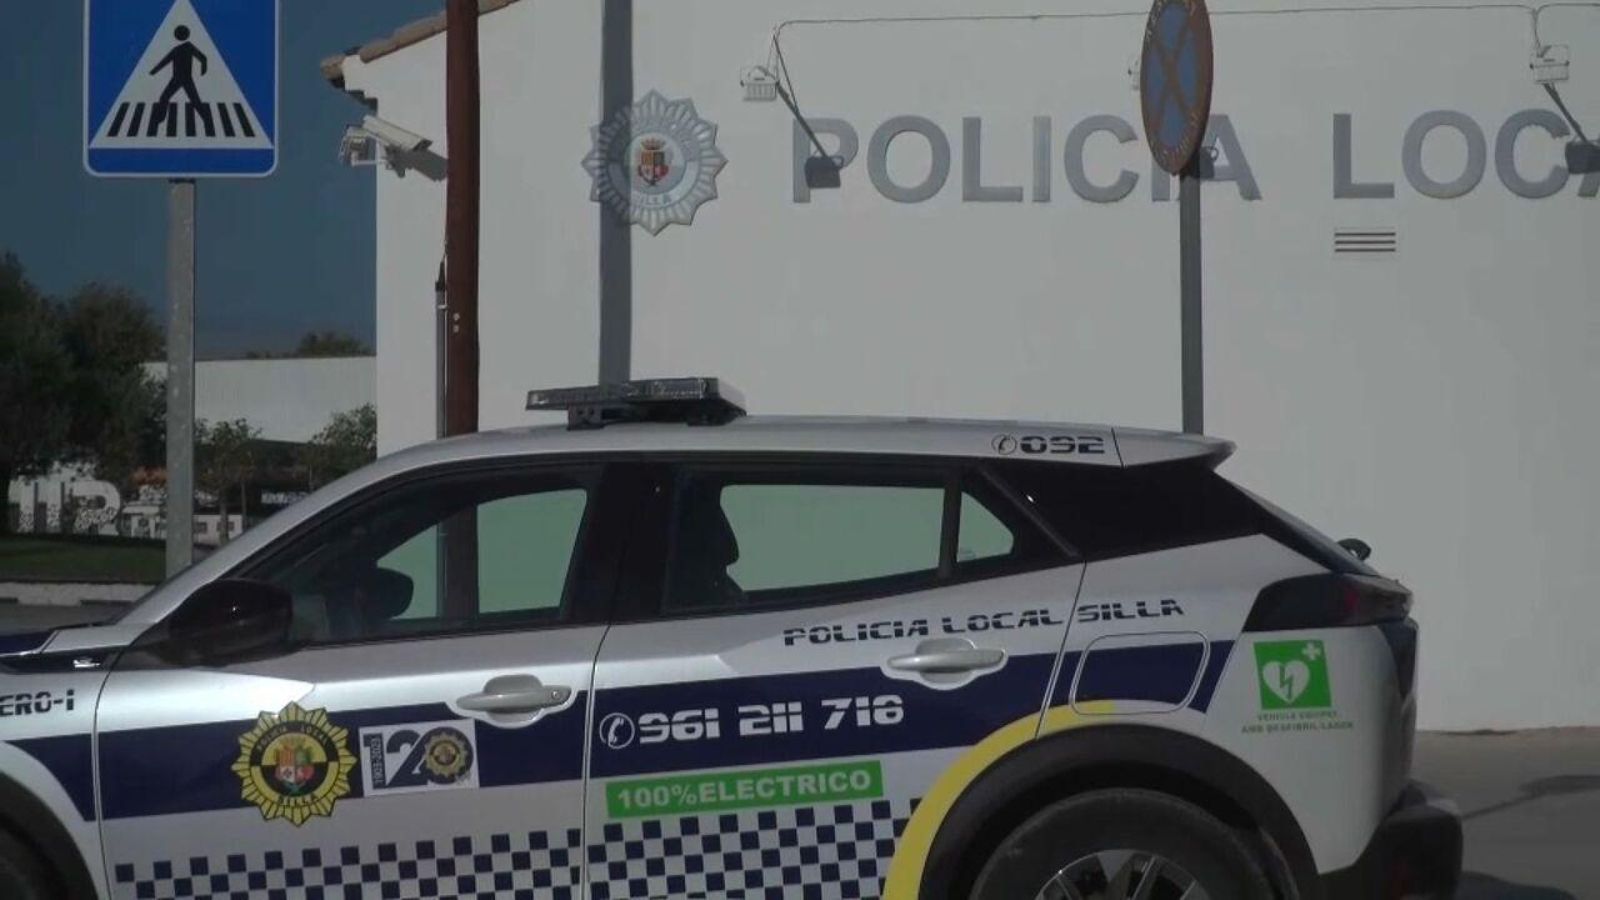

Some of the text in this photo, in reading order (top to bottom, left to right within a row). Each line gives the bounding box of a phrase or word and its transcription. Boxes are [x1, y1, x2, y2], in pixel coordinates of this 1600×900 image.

[1020, 436, 1105, 454] 092
[783, 599, 1184, 646] POLICIA LOCAL SILLA
[638, 708, 720, 743] 961
[738, 701, 804, 736] 211
[617, 768, 872, 810] 100%ELECTRICO
